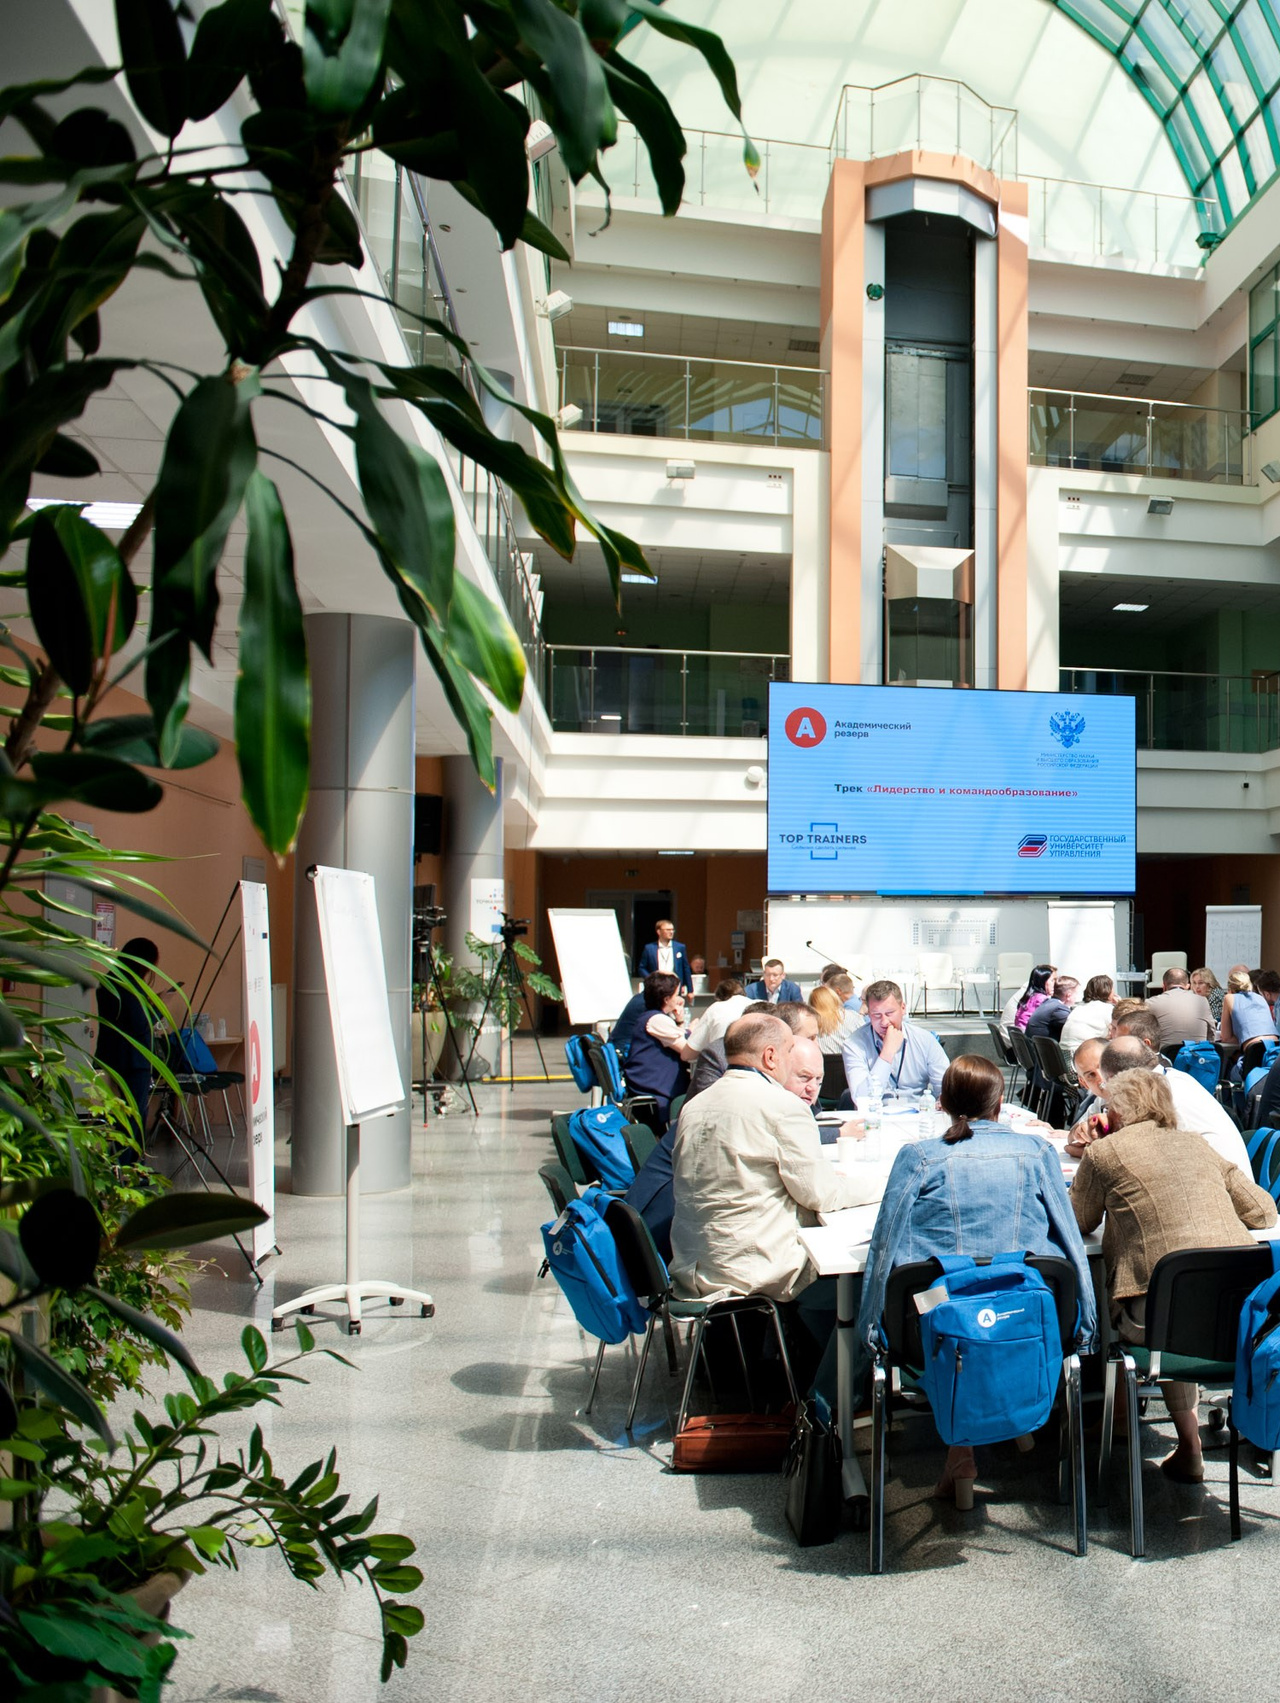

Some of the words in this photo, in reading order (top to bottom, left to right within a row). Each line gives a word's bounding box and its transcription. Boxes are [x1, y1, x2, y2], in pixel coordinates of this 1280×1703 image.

[834, 720, 912, 730] Академический
[834, 730, 869, 739] резерв
[834, 783, 863, 794] Трек
[867, 784, 936, 795] «Лидерство
[949, 787, 1078, 797] командообразование»
[779, 834, 804, 843] TOP
[807, 834, 867, 844] TRAINERS
[1049, 834, 1127, 843] ГОСУДАРСТВЕННЫЙ
[1049, 850, 1101, 858] УПРАВЛЕНИЯ
